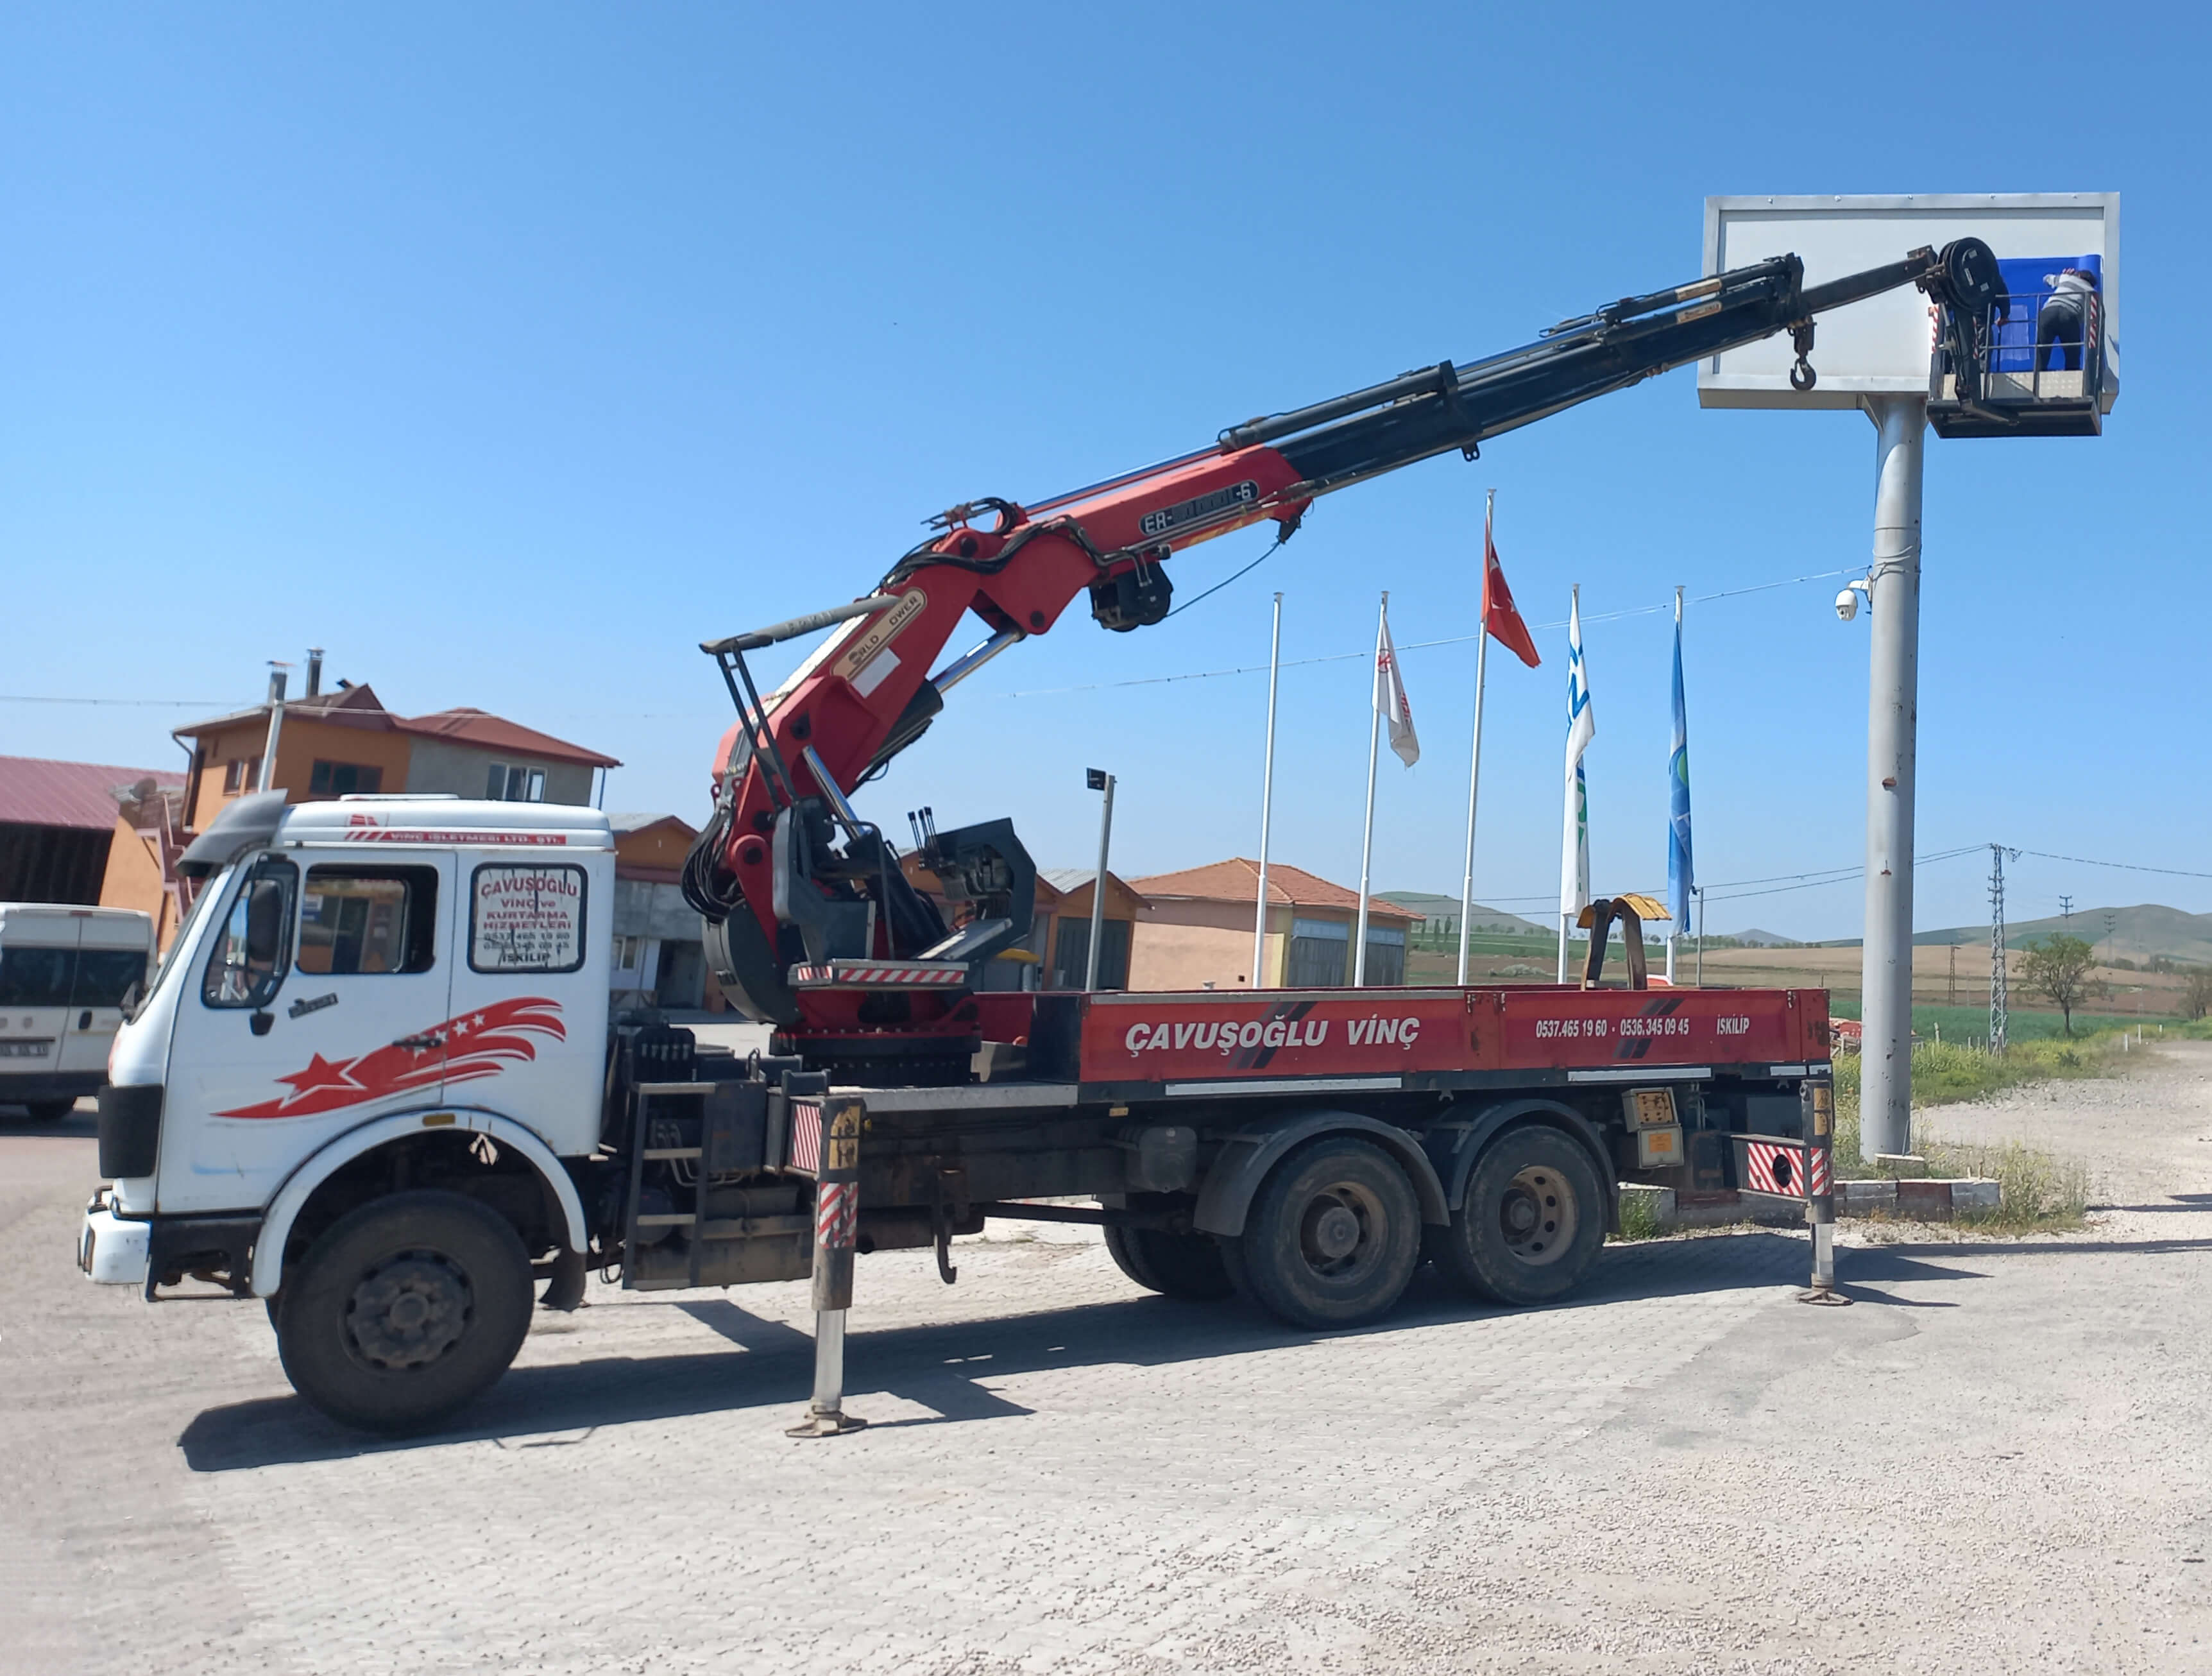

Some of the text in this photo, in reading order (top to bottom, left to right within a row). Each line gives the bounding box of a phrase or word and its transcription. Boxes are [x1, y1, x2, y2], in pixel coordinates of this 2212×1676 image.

[486, 911, 568, 919] KURTARMA
[1536, 1019, 1579, 1038] 0537.465
[1583, 1020, 1594, 1036] 19
[1595, 1019, 1607, 1036] 60
[1665, 1018, 1676, 1035] 09
[1678, 1018, 1689, 1035] 45
[1717, 1013, 1750, 1035] İSKİLİP
[1126, 1013, 1420, 1057] ÇAVUŞOĞLU VİNÇ
